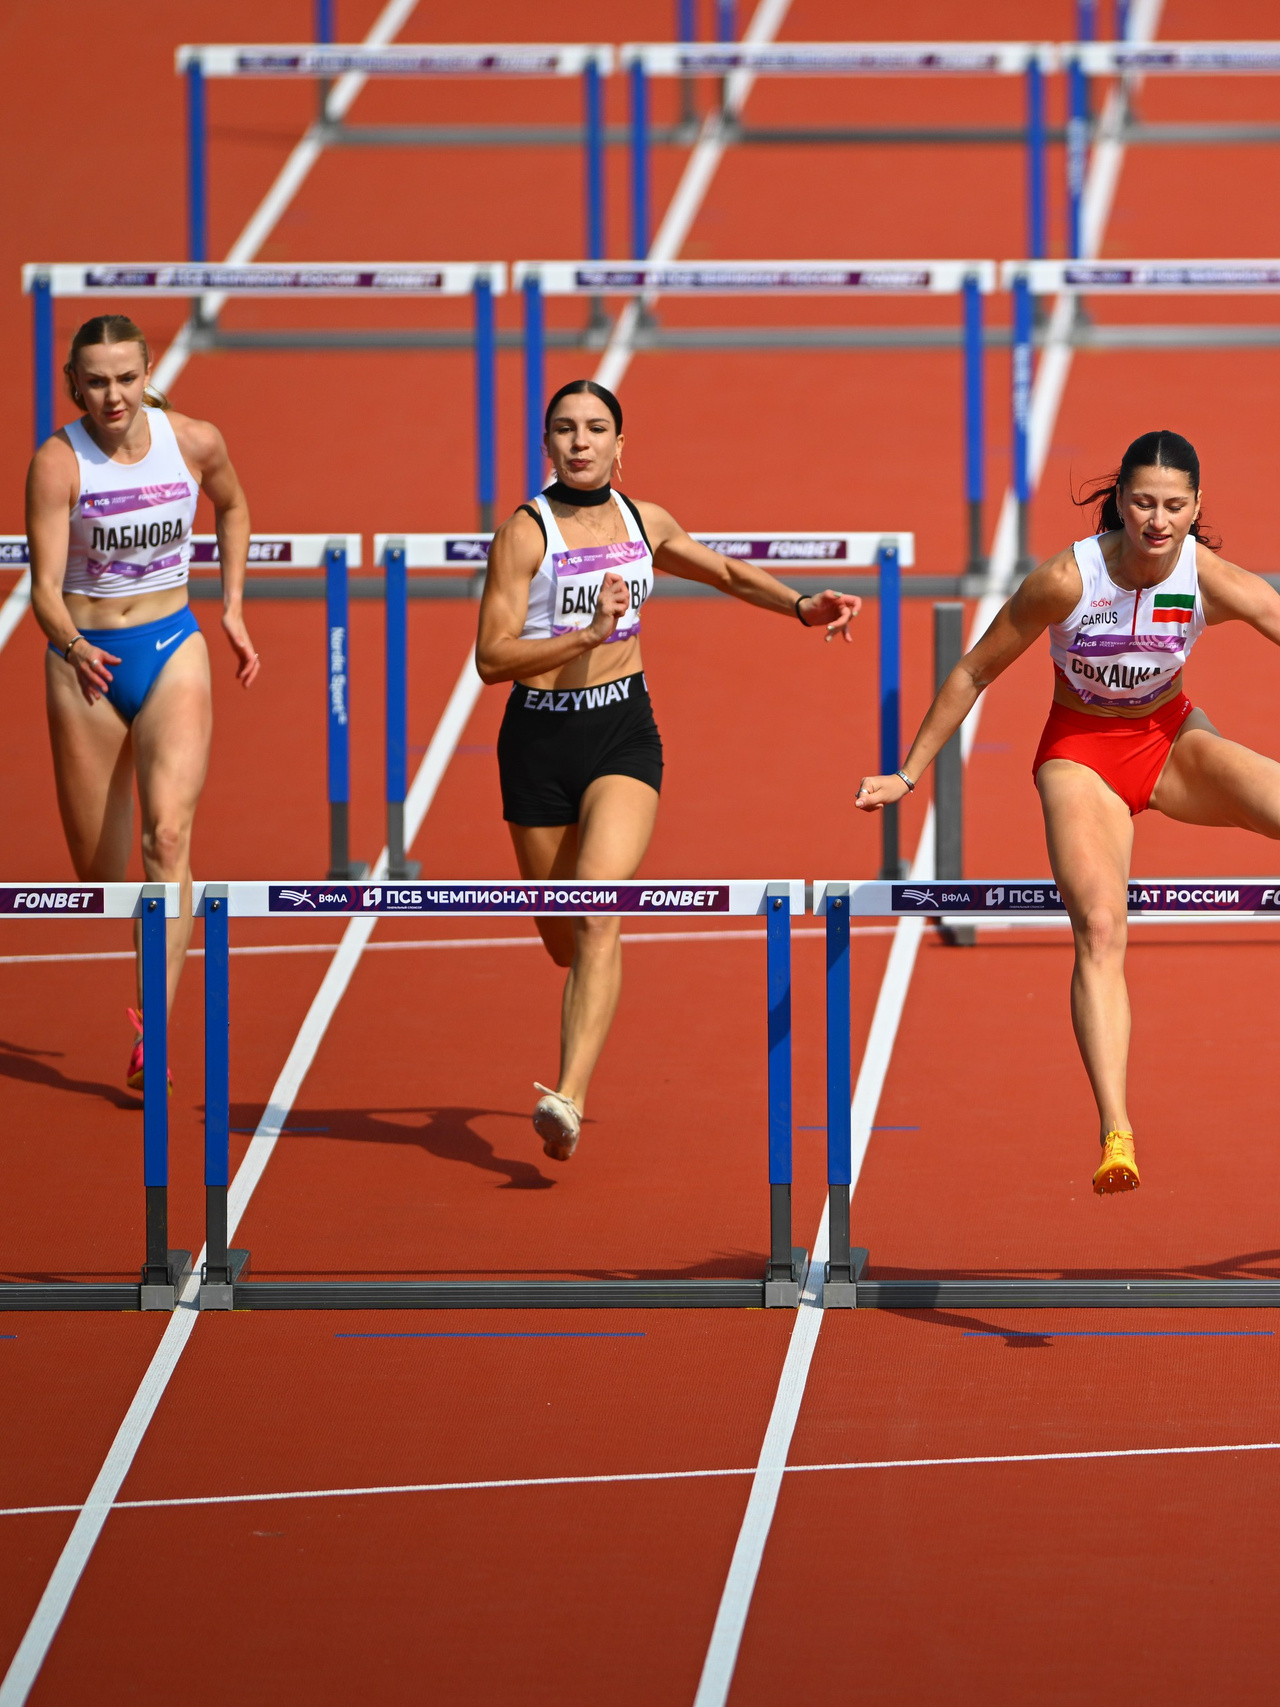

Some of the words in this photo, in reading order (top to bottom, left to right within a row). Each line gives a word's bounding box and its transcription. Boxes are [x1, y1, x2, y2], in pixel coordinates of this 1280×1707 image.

[91, 518, 184, 552] ЛАБЦОВА
[767, 541, 843, 558] FONBET
[1081, 611, 1119, 626] CARIUS
[524, 678, 632, 712] EAZYWAY
[13, 892, 94, 908] FONBET
[318, 893, 349, 904] ВФЛА
[386, 889, 423, 904] ПСБ
[426, 889, 539, 904] ЧЕМПИОНАТ
[544, 890, 618, 904] РОССИИ
[638, 890, 720, 906] FONBET
[941, 892, 971, 903] ВФЛА
[1009, 889, 1046, 904] ПСБ
[1166, 890, 1240, 904] РОССИИ
